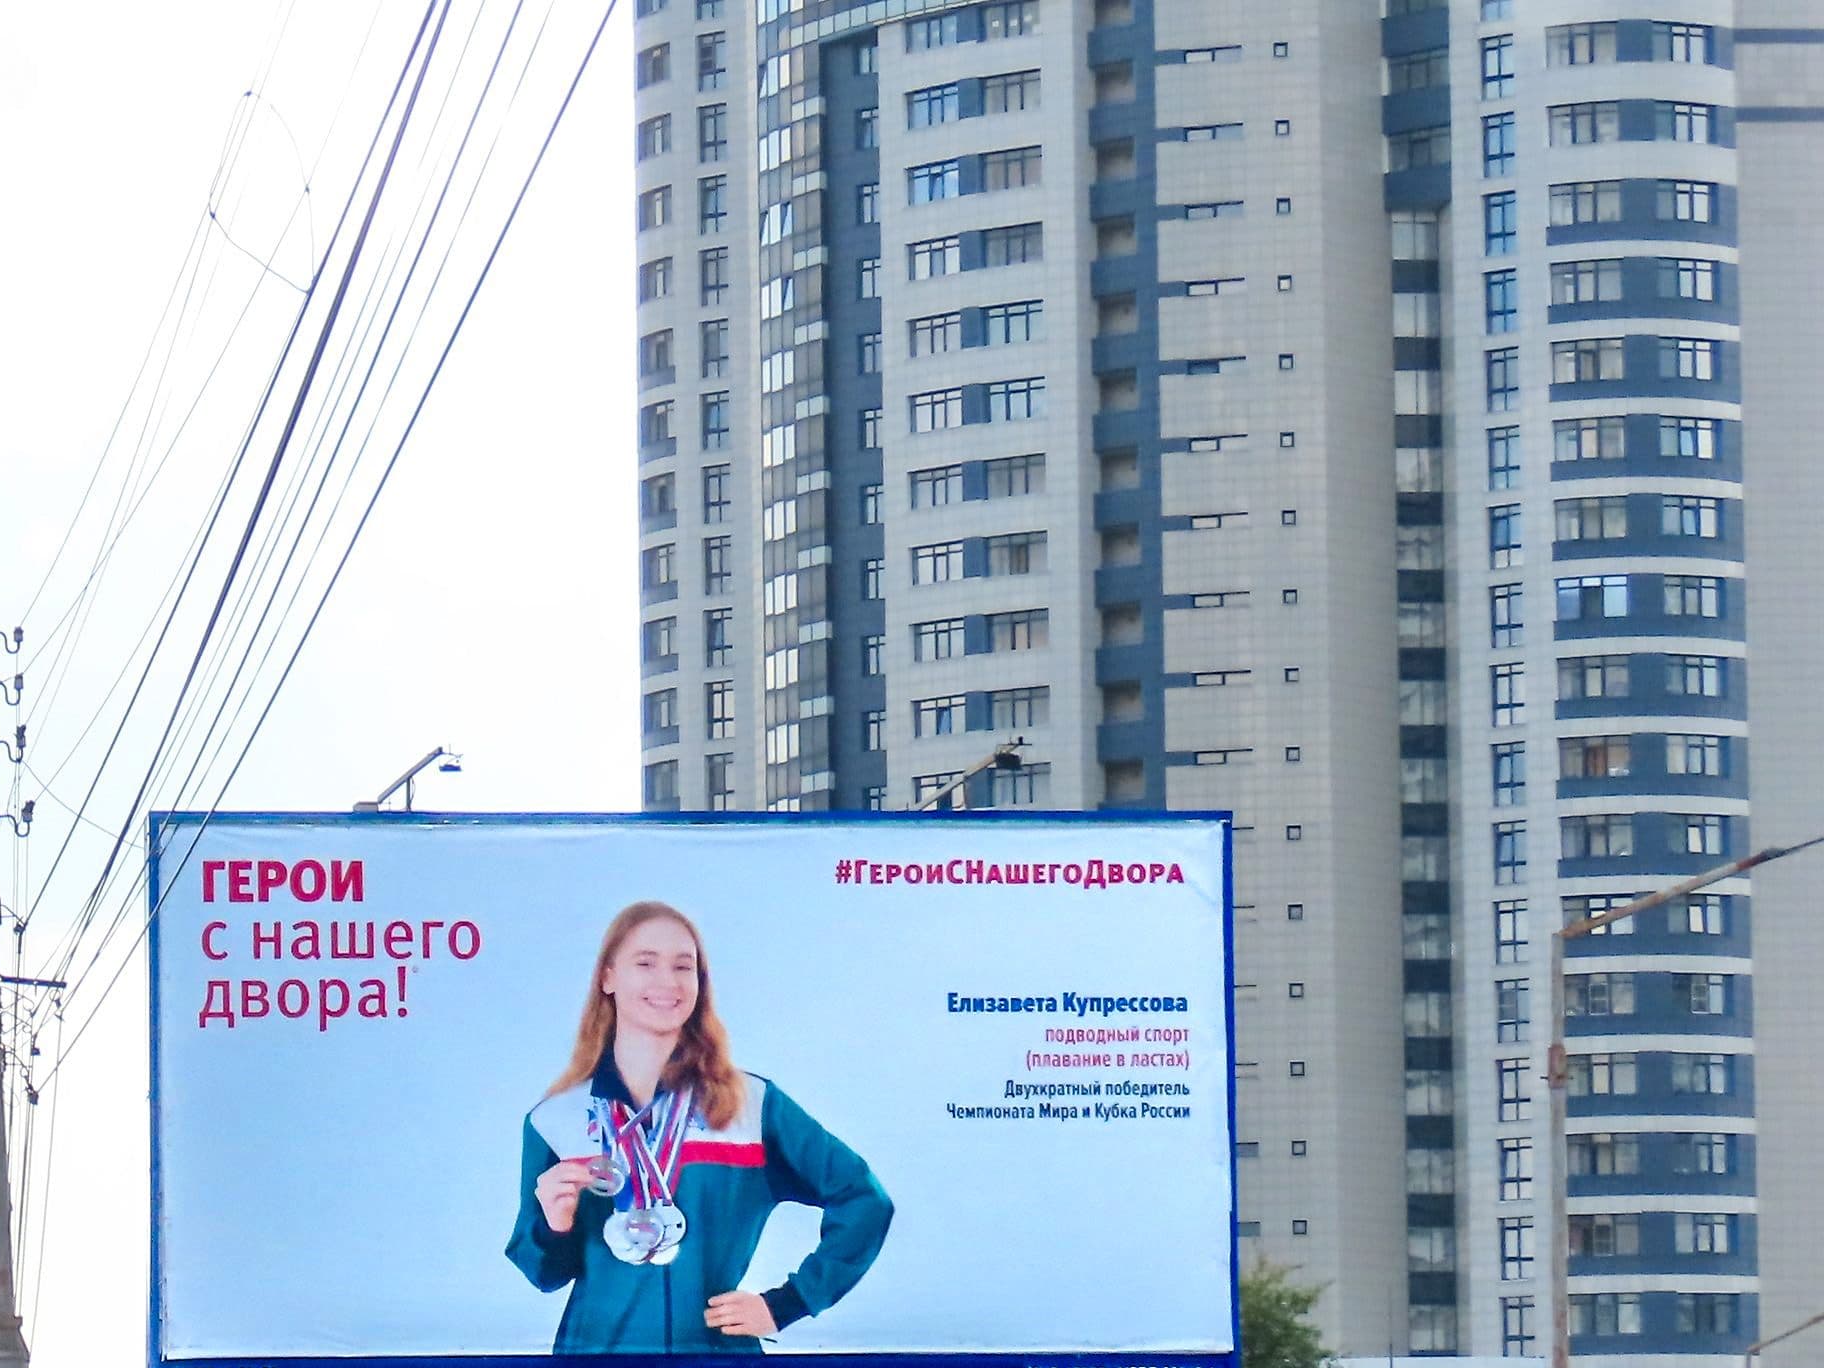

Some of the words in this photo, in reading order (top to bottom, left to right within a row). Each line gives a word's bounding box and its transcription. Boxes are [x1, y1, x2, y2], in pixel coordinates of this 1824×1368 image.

[202, 859, 364, 902] ГЕРОИ
[201, 921, 229, 961] с
[252, 920, 481, 960] нашего
[199, 966, 408, 1032] двора!
[947, 992, 1057, 1013] Елизавета
[1062, 991, 1188, 1018] Купрессова
[1045, 1026, 1140, 1045] подводный
[1144, 1027, 1189, 1046] спорт
[1026, 1050, 1111, 1071] (плавание
[1116, 1053, 1126, 1068] в
[1130, 1050, 1190, 1071] ластах)
[1004, 1079, 1101, 1099] Двухкратный
[1105, 1080, 1190, 1099] победитель
[946, 1103, 1034, 1119] Чемпионата
[1038, 1103, 1077, 1122] Мира
[1081, 1106, 1091, 1118] и
[1095, 1103, 1137, 1122] Кубка
[1141, 1102, 1191, 1119] России
